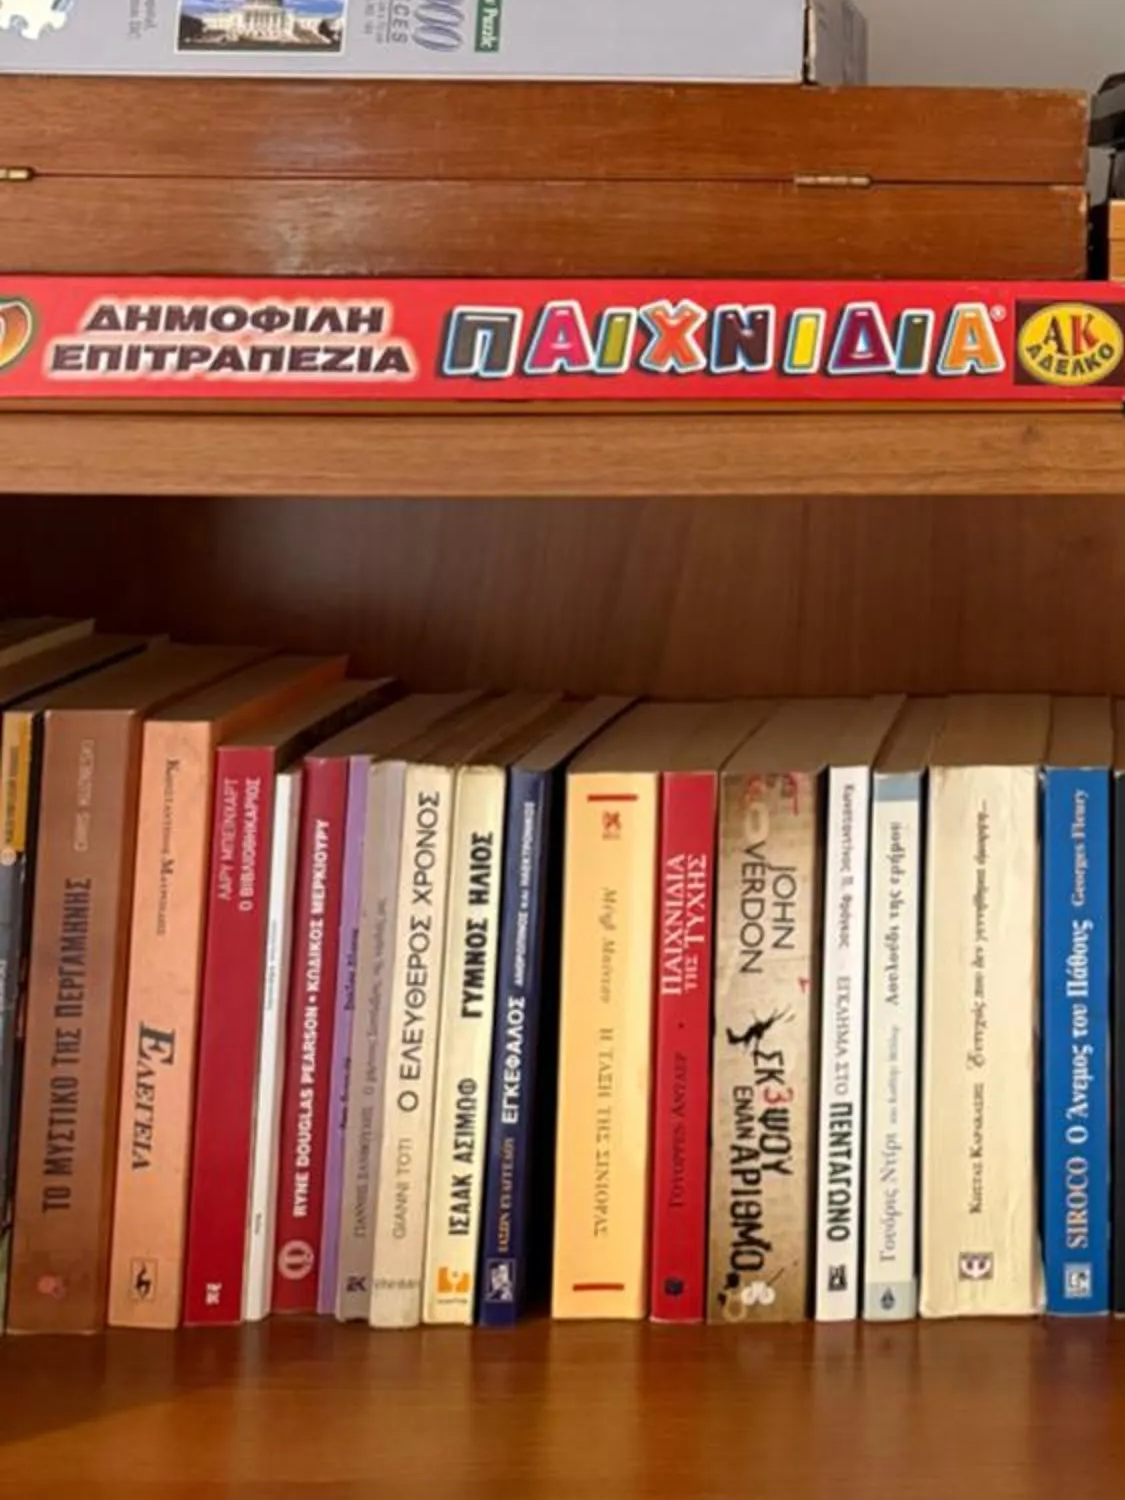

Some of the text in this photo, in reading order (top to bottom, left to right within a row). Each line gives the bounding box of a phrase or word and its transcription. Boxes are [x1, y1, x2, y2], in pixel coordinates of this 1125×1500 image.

[50, 343, 410, 374] ΕΠΙΤΡΑΠΕΖΙΑ
[85, 303, 384, 334] ΔΗΜΟΦΙΛΗ
[443, 299, 1006, 377] ΠΑΙΧΝΙΔΙΑ
[1026, 340, 1117, 379] ΑΔΕΛΚΟ
[1043, 314, 1099, 353] ΑΚ
[219, 778, 239, 901] ΛΑΡΥ ΜΠΕΙΝΧΑΡΤ
[238, 777, 262, 911] Ο ΒΙΒΛΙΟΘΗΚΑΡΙΟΣ
[305, 820, 330, 992] ΚΩΔΙΚΟΣ ΜΕΡΚΙΟΥΡΥ
[739, 840, 766, 975] VERDON
[769, 864, 797, 950] JOHN
[1071, 789, 1090, 907] Georges Fleury
[397, 793, 440, 1113] Ο ΕΛΕΥΘΕΡΟΣ ΧΡΟΝΟΣ
[459, 831, 493, 1018] ΓΥΜΝΟΣ ΗΛΙΟΣ
[659, 854, 684, 996] ΠΑΙΧΝΙΔΙΑ
[682, 854, 707, 991] ΤΗΣ ΤΥΧΗΣ
[882, 821, 907, 1007] Λουλούδι της ερήμου
[41, 879, 91, 1213] ΤΟ ΜΥΣΤΙΚΟ ΤΗΣ ΠΕΡΓΑΜΗΝΗΣ
[131, 1021, 176, 1171] ΕΛΕΓΕΙΑ
[500, 996, 525, 1124] ΕΓΚΕΦΑΛΟΣ
[1065, 919, 1091, 1145] Ο Άνεμος του Πάθους
[293, 1006, 319, 1217] RYNE DOUGLAS PEARSON
[447, 1078, 476, 1236] ΙΣΑΑΚ ΑΣΙΜΩΦ
[593, 1029, 612, 1238] Η ΤΑΞΗ ΤΗΣ ΣΙΝΙΟΡΑΣ
[826, 975, 854, 1242] ΕΓΚΛΗΜΑ ΣΤΟ ΠΕΝΤΑΓΩΝΟ
[729, 1085, 772, 1274] ΕΝΑΝ ΑΡΙΘΜΟ
[877, 1132, 902, 1263] Γουόρις Ντίρι
[1065, 1157, 1089, 1250] SIROCO
